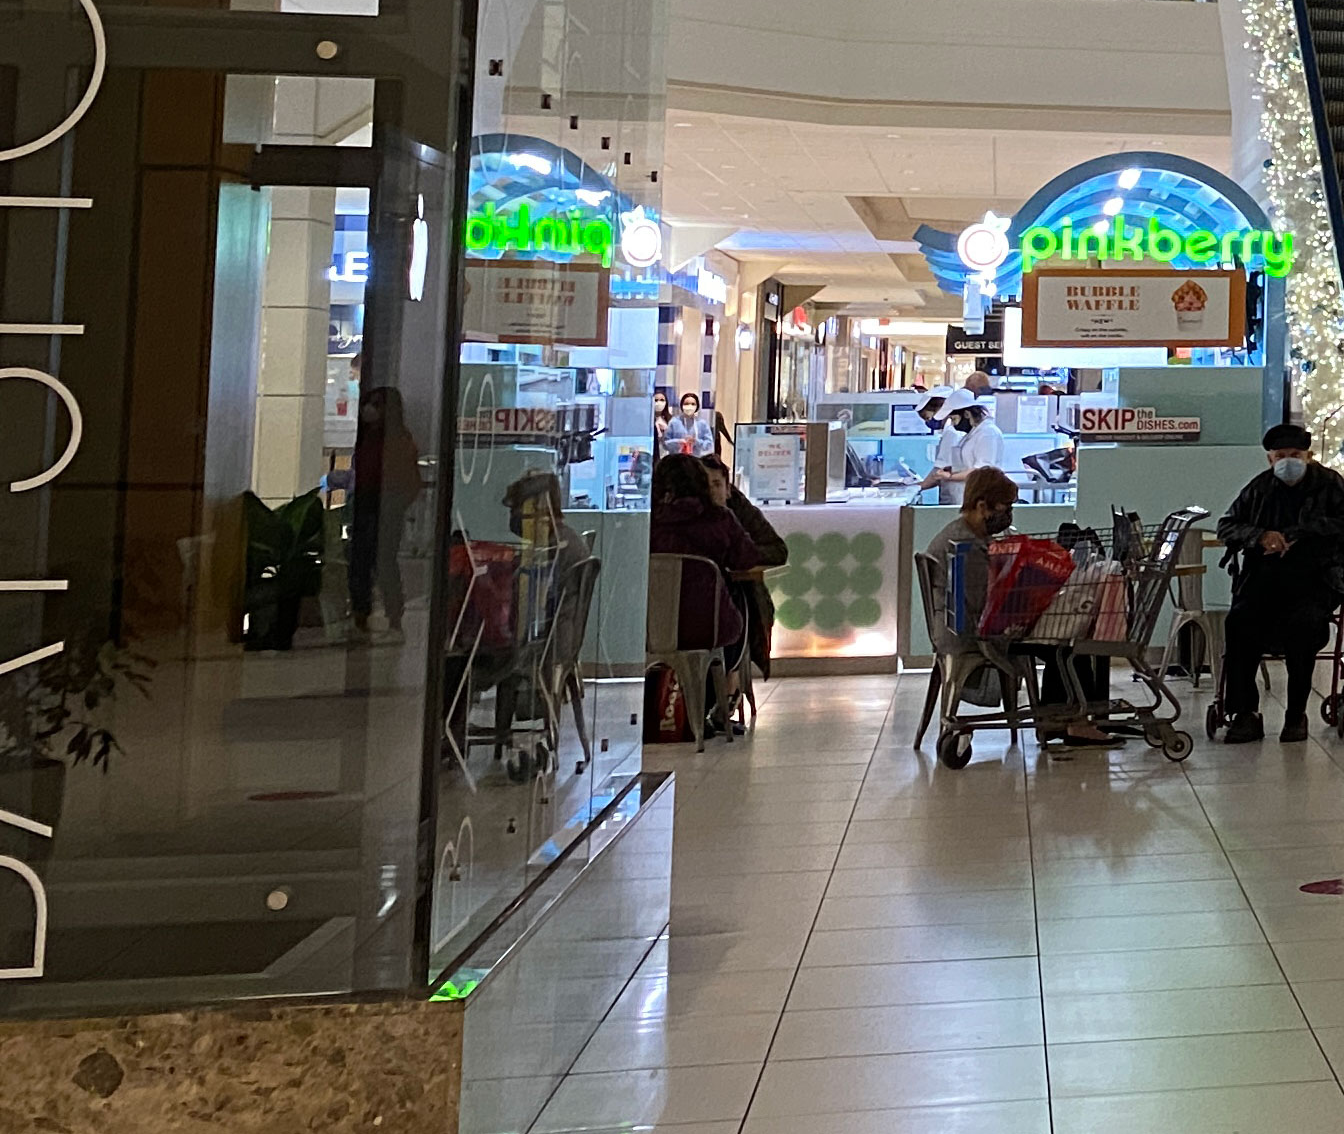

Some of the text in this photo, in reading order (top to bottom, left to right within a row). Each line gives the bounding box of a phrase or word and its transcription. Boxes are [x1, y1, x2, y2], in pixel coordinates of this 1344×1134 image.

[1021, 214, 1294, 278] pinkberry
[1066, 285, 1140, 298] BUBBLE
[1066, 299, 1141, 311] WAFFLE
[954, 341, 986, 350] GUEST
[1082, 408, 1199, 431] SKIP the DISHES.com
